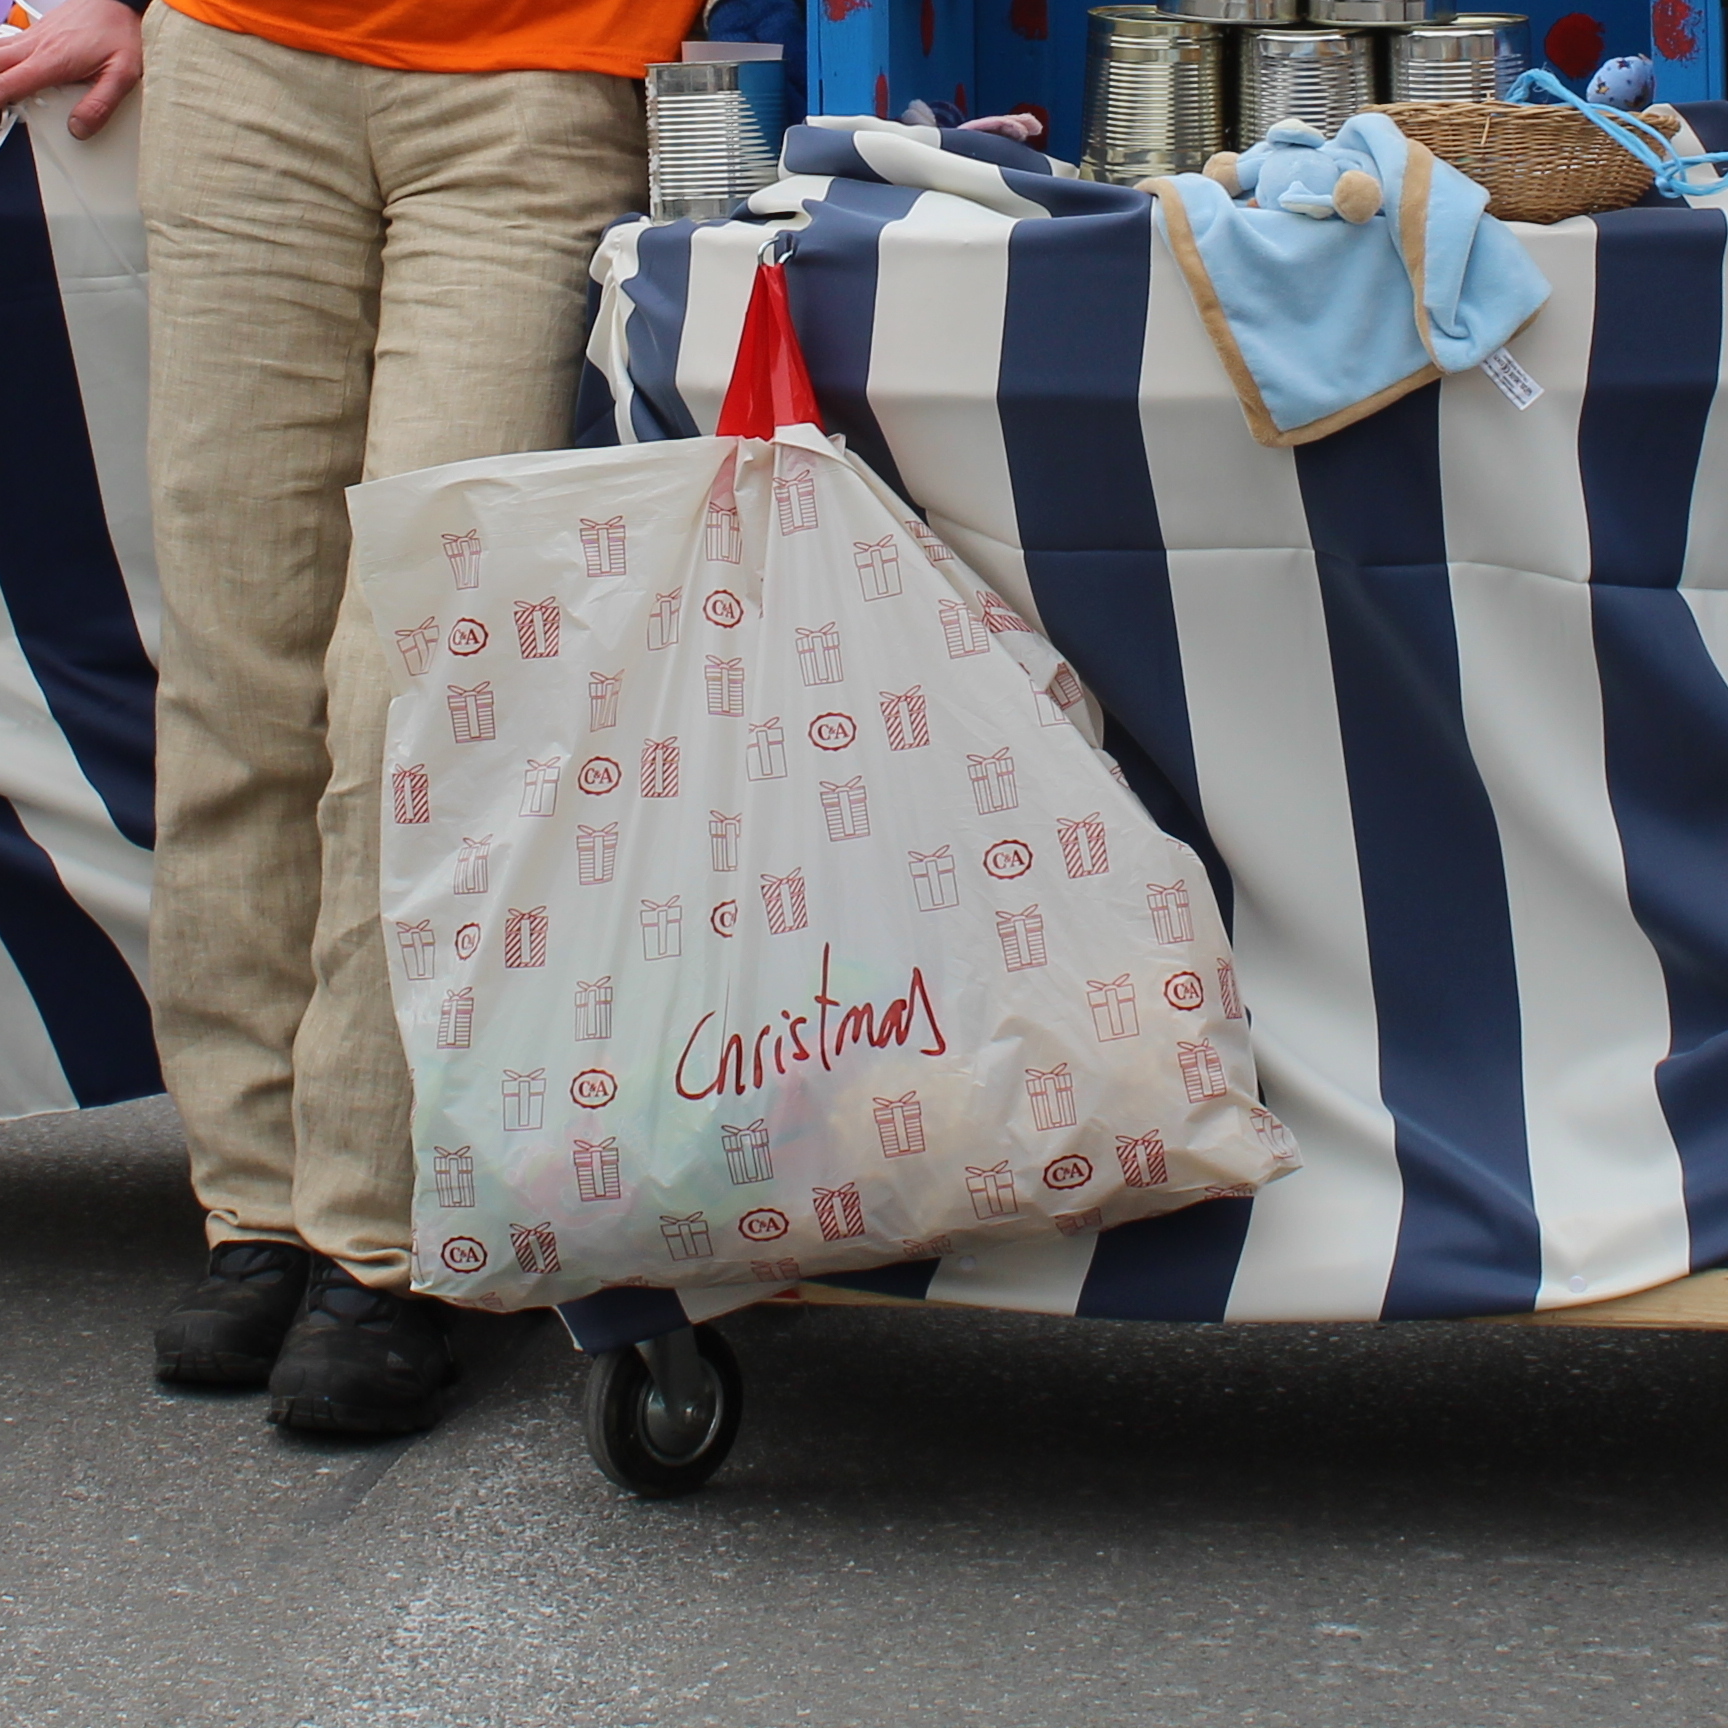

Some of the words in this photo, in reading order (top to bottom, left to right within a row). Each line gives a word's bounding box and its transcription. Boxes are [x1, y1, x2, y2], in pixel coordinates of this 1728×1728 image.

[711, 599, 736, 620] C&A
[452, 628, 481, 646] C&A
[817, 722, 850, 741] C&A
[584, 767, 614, 785] C&A
[992, 849, 1026, 869] C&A
[1173, 981, 1200, 1000] C&A
[674, 941, 947, 1101] Christmas
[578, 1079, 610, 1098] C&A
[1052, 1161, 1085, 1182] C&A
[747, 1216, 781, 1234] C&A
[449, 1246, 481, 1263] C&A
